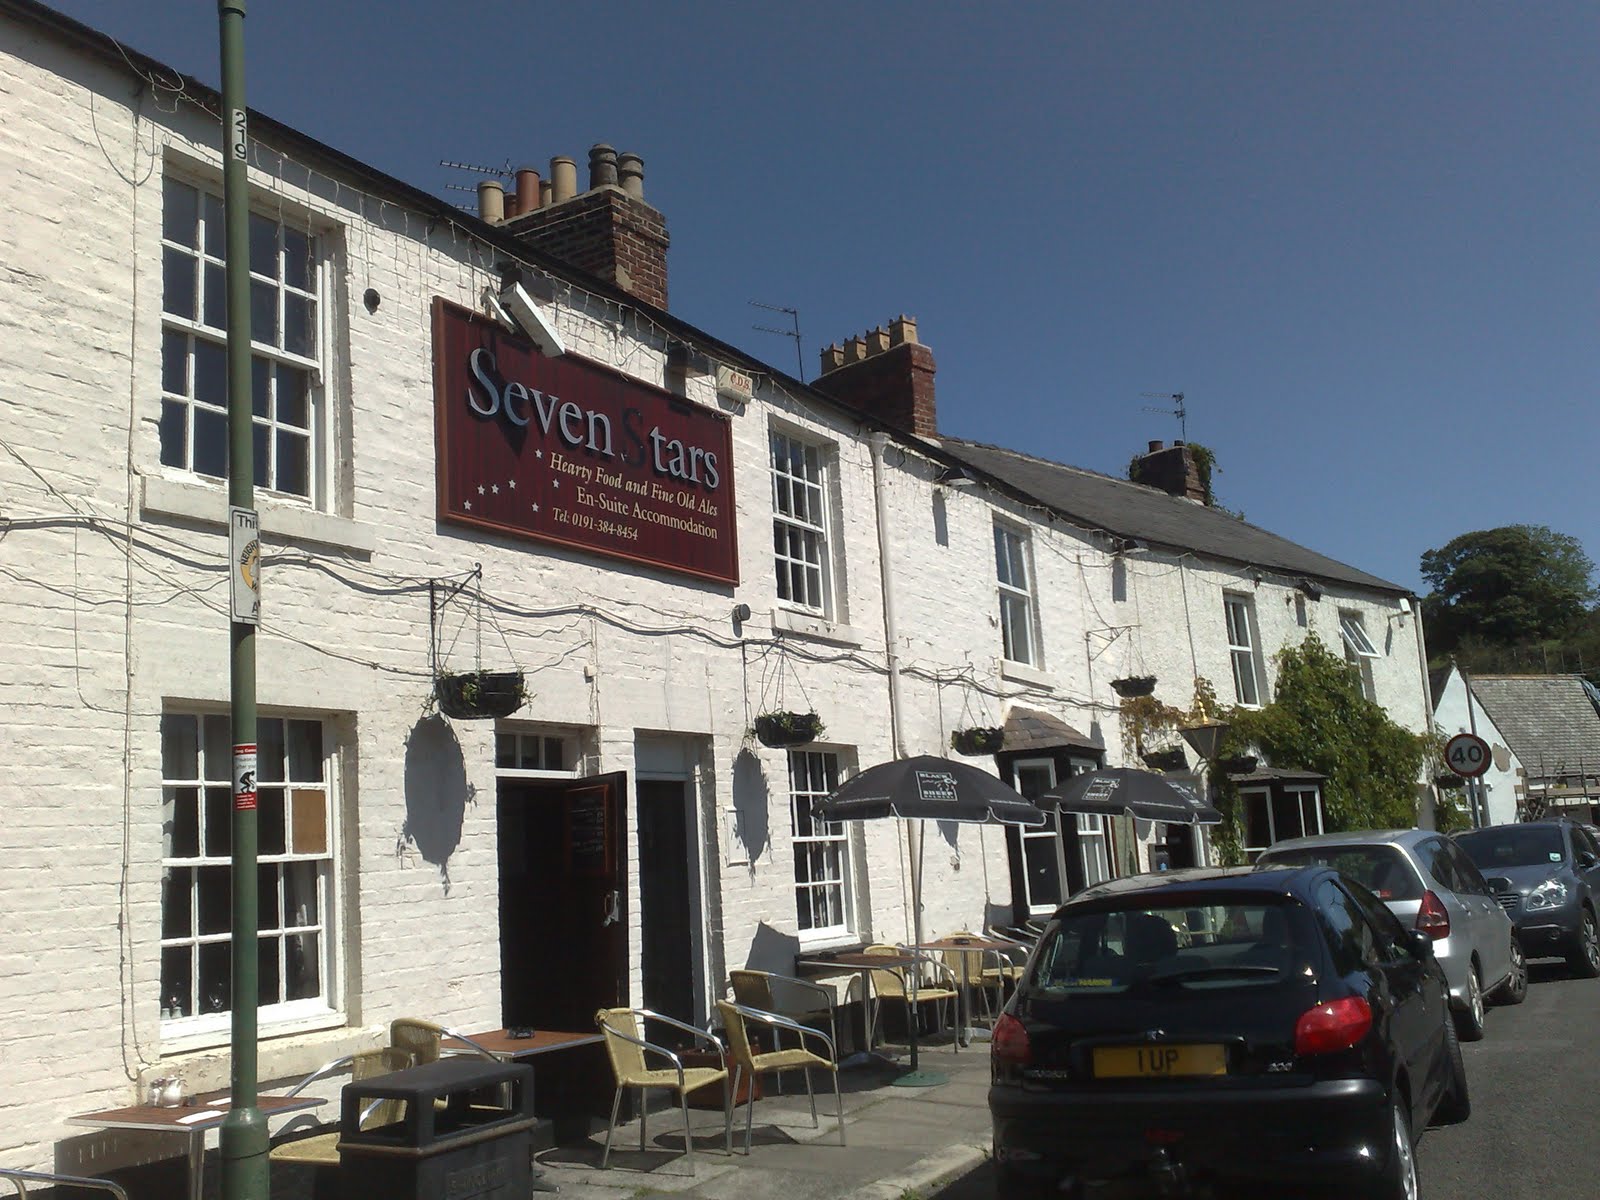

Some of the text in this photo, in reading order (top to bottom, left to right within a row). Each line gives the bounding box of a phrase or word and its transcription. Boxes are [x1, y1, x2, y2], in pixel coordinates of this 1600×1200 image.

[235, 111, 247, 160] 219
[467, 347, 616, 457] Seven
[550, 452, 718, 517] Hearty Food and Fine Old Ales
[552, 507, 639, 542] Tel: 0191-384-8454
[576, 486, 719, 540] En-Suite Accommodation
[1451, 745, 1483, 764] 40
[1150, 1051, 1180, 1072] UP
